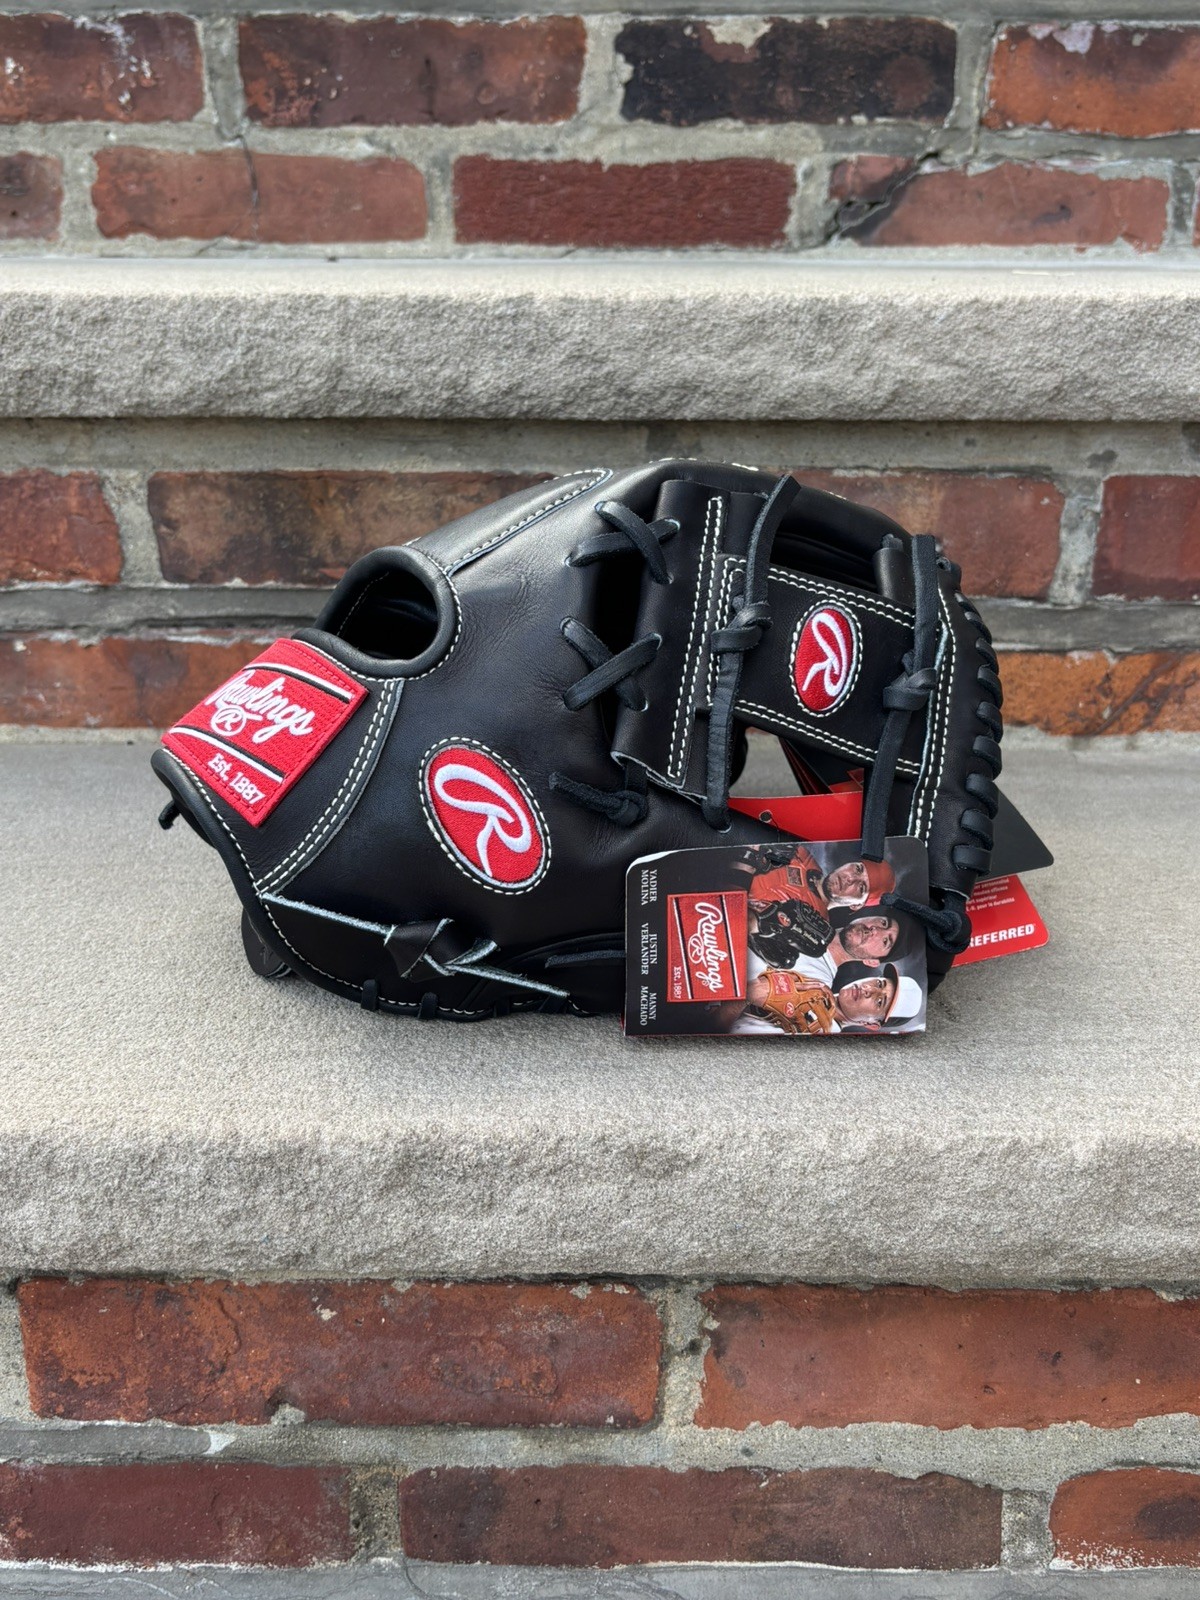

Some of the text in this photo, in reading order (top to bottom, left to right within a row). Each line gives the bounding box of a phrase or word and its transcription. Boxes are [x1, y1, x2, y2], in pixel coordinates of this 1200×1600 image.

[802, 612, 847, 697] R
[204, 669, 315, 744] Rawlings
[207, 752, 266, 805] Est. 1887
[434, 763, 532, 877] R
[641, 869, 649, 906] MOLINA
[650, 869, 658, 902] YADIER
[641, 923, 649, 975] VERLANDER
[649, 933, 658, 965] JUSTIN
[695, 902, 728, 993] Rawlings
[673, 966, 682, 981] Est.
[640, 986, 649, 1026] MACHADO
[649, 993, 657, 1020] MANNY
